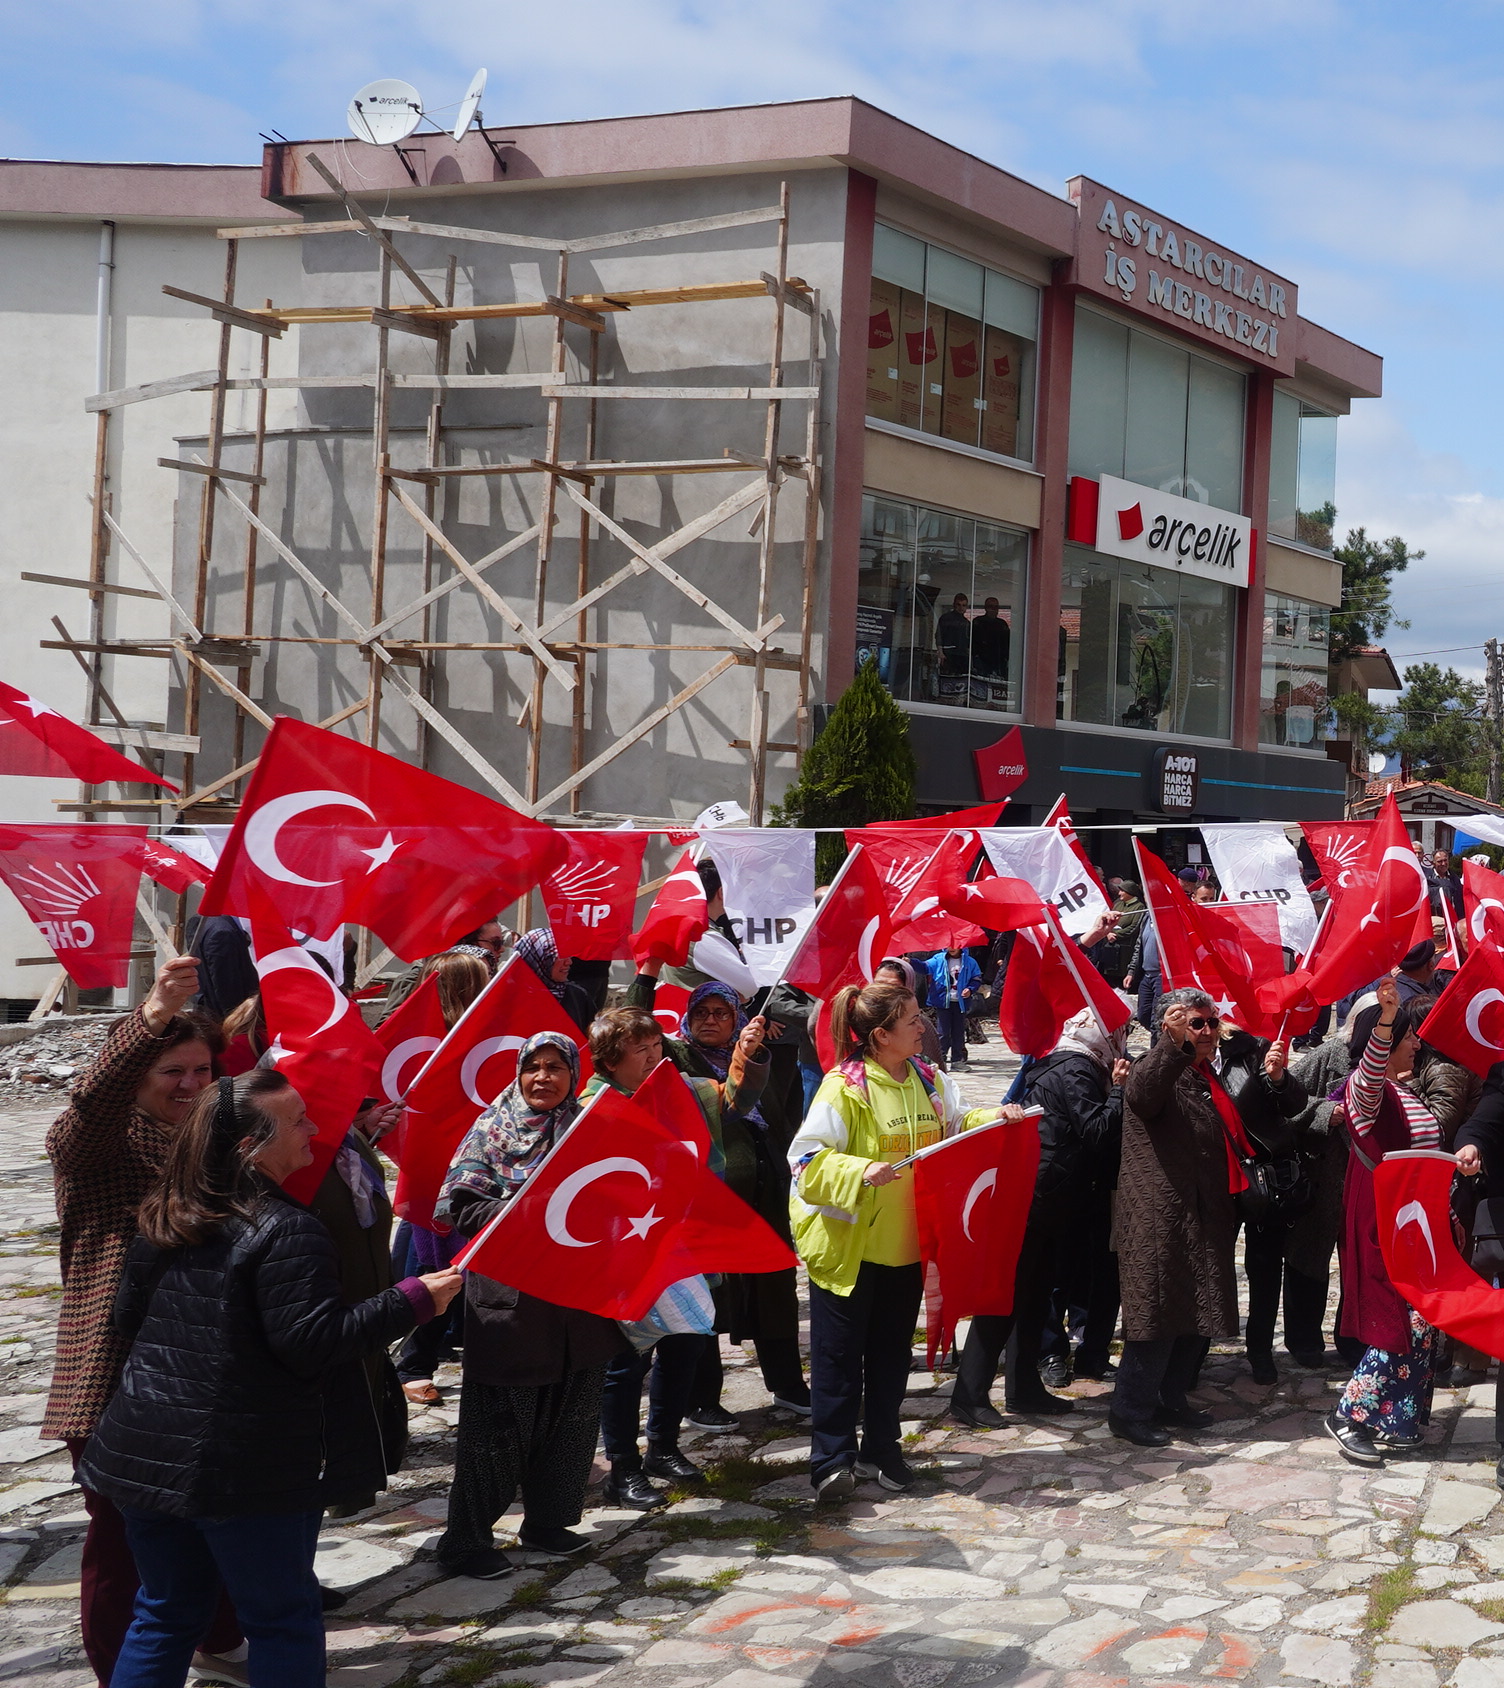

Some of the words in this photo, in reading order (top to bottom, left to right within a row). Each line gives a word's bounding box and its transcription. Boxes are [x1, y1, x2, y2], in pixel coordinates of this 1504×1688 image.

[1097, 199, 1287, 319] ASTARCILAR
[1104, 241, 1137, 301] İŞ
[1147, 269, 1279, 358] MERKEZİ
[1147, 514, 1241, 568] arçelik
[998, 764, 1025, 778] arçelik
[1164, 773, 1192, 786] HARCA
[1164, 784, 1192, 796] HARCA
[1046, 882, 1088, 919] HP
[547, 904, 611, 928] CHP
[729, 917, 797, 945] CHP
